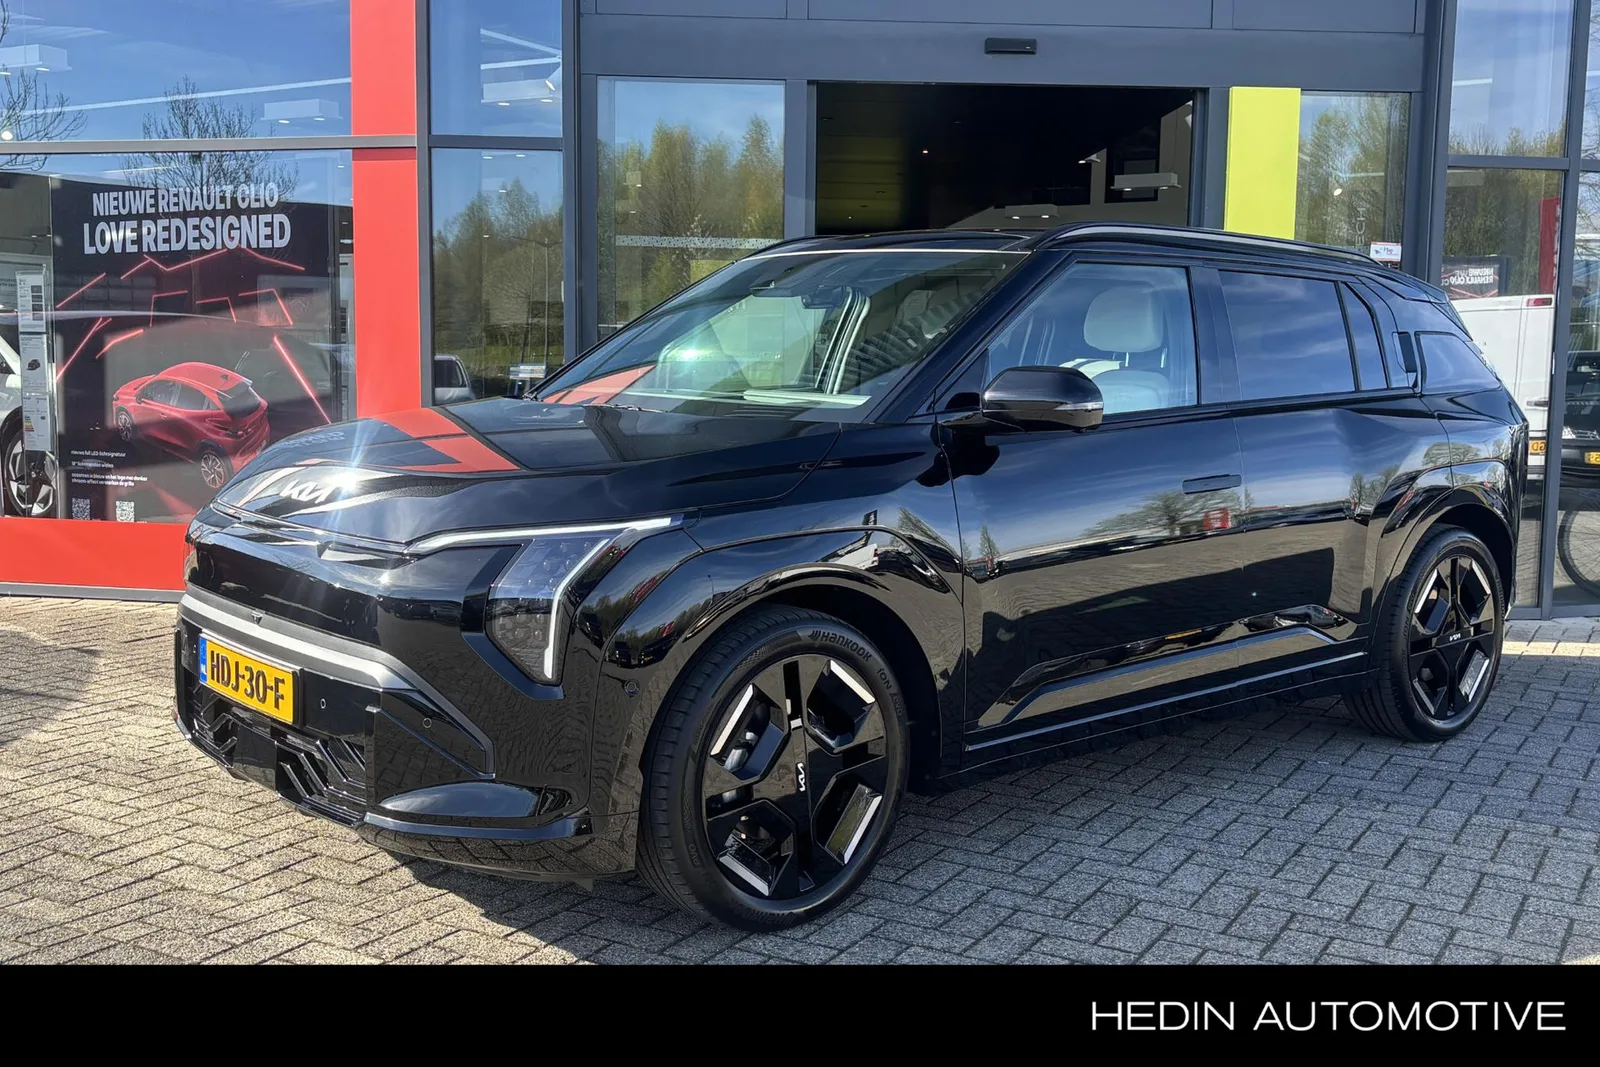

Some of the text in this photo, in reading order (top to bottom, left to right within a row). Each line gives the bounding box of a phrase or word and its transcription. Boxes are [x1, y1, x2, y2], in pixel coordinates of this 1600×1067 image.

[92, 182, 279, 216] NIEUWE RENAULT CLIO
[84, 213, 291, 254] LOVE REDESIGNED
[210, 650, 286, 711] HDJ-30-F
